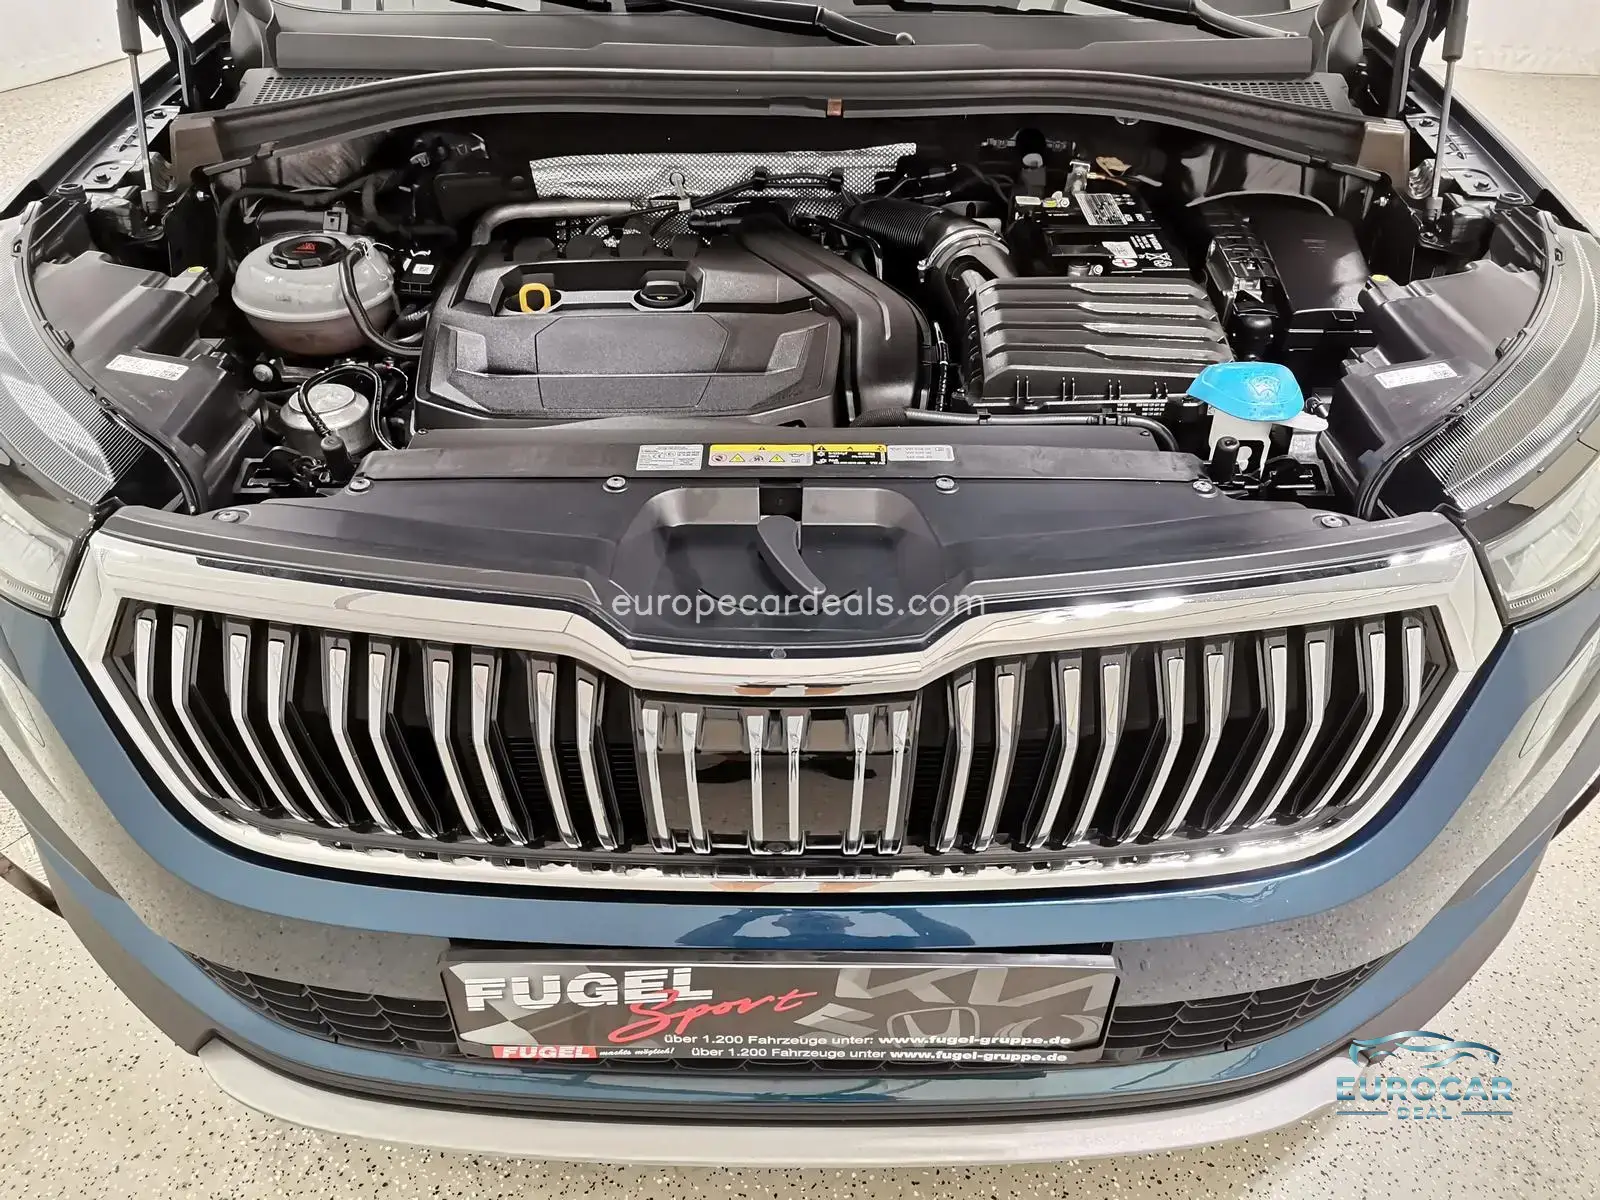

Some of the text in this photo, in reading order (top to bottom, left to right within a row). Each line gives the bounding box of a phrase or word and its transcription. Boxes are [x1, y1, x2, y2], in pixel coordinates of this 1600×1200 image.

[464, 967, 713, 1011] FUGEL
[607, 988, 818, 1044] Sport
[664, 1033, 1072, 1048] über 1.200 Fahrzeuge unter: www.fugel-gruppe.de
[502, 1045, 590, 1058] FUGEL
[691, 1047, 1068, 1063] über 1.200 Fahrzeuge unter www.fugel-gruppe.de
